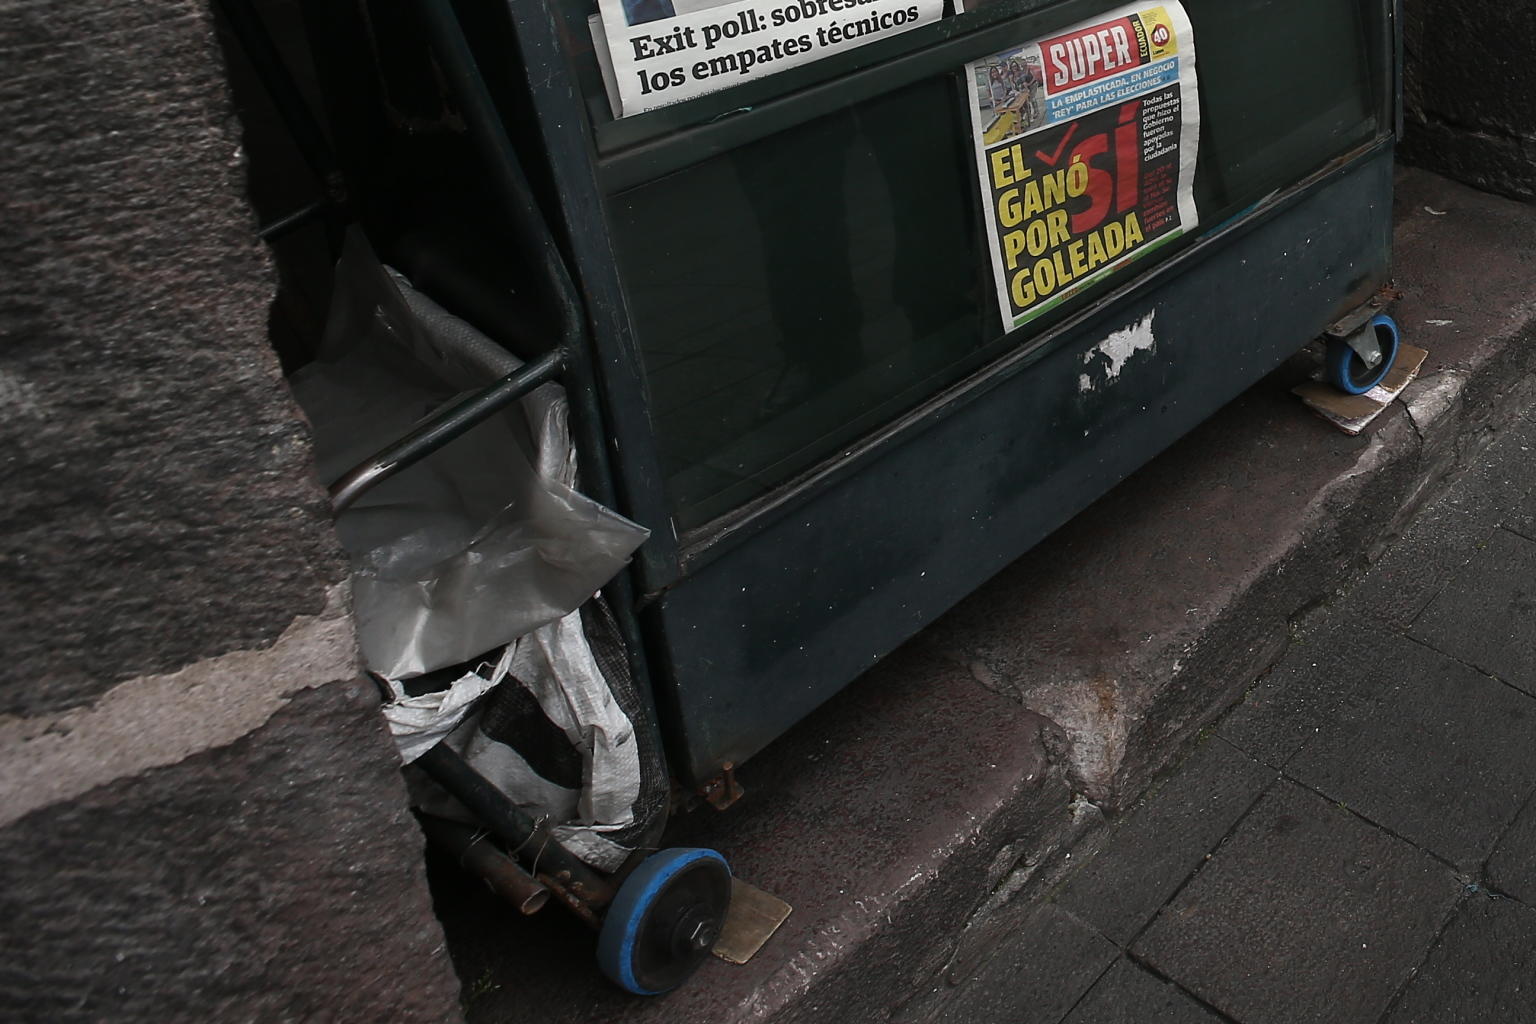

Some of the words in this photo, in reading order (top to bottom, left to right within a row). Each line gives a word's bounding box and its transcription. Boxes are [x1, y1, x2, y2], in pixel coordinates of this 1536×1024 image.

[630, 25, 697, 62] Exit
[702, 10, 768, 51] poll:
[637, 63, 686, 95] los
[692, 33, 813, 75] empates
[818, 3, 920, 48] técnicos
[1132, 20, 1148, 57] ECUADOR
[1153, 27, 1168, 43] 40
[1050, 25, 1132, 87] SUPER
[1052, 99, 1063, 109] LA
[1065, 77, 1129, 106] EMPLASTICADA,
[1131, 73, 1141, 83] EN
[1143, 61, 1175, 78] NEGOCIO
[1076, 97, 1099, 112] PARA
[1100, 90, 1115, 103] LAS
[1116, 76, 1161, 98] ELECCIONES
[1143, 96, 1163, 107] Todas
[1143, 98, 1180, 116] propuestas
[1143, 114, 1155, 123] que
[1157, 109, 1171, 117] hizo
[1143, 116, 1174, 130] Gobierno
[1143, 126, 1165, 138] fueron
[1144, 131, 1173, 147] apoyadas
[1144, 145, 1155, 156] por
[990, 143, 1031, 190] EL
[1069, 100, 1142, 234] SÍ
[998, 154, 1090, 228] GANÓ
[1002, 209, 1070, 270] POR
[1010, 211, 1143, 308] GOLEADA
